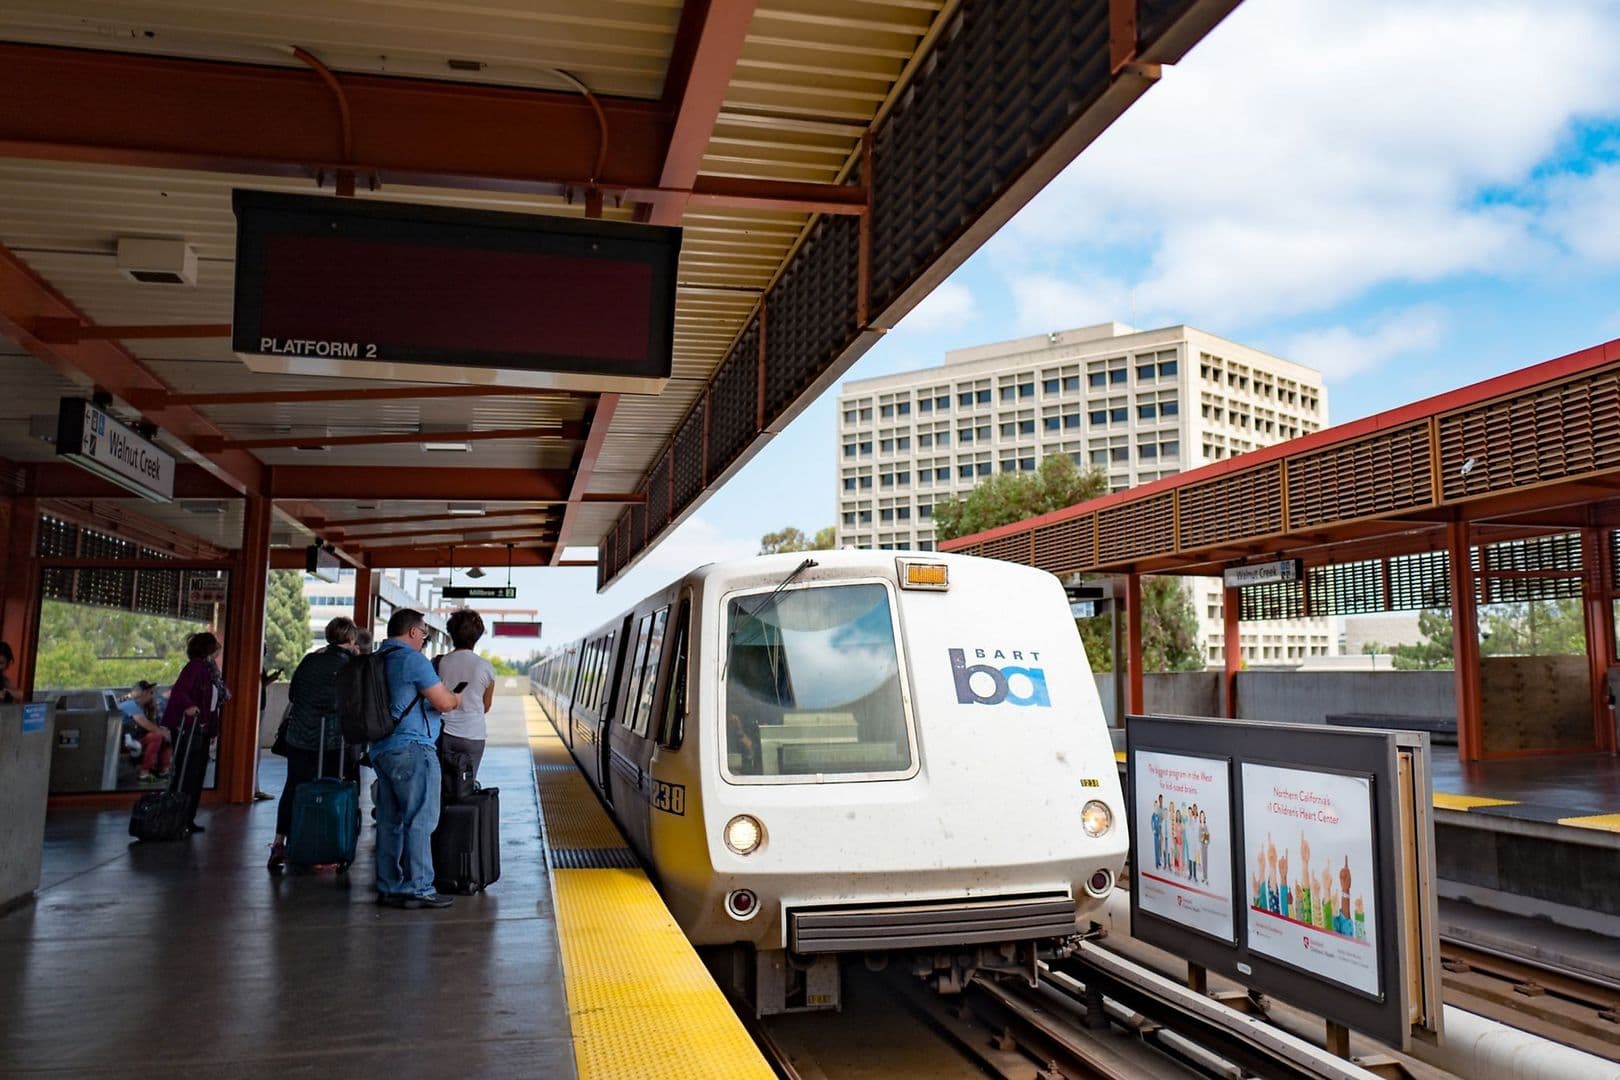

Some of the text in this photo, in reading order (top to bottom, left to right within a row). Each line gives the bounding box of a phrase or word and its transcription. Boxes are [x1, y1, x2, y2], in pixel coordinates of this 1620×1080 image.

[260, 337, 377, 358] PLATFORM 2
[109, 430, 160, 480] Walnut Creek
[1236, 566, 1276, 580] Walnut Creek
[191, 578, 203, 591] NO
[975, 648, 1040, 662] BART
[1273, 786, 1298, 800] Northern
[1299, 808, 1316, 821] Heart
[1318, 810, 1339, 825] Center
